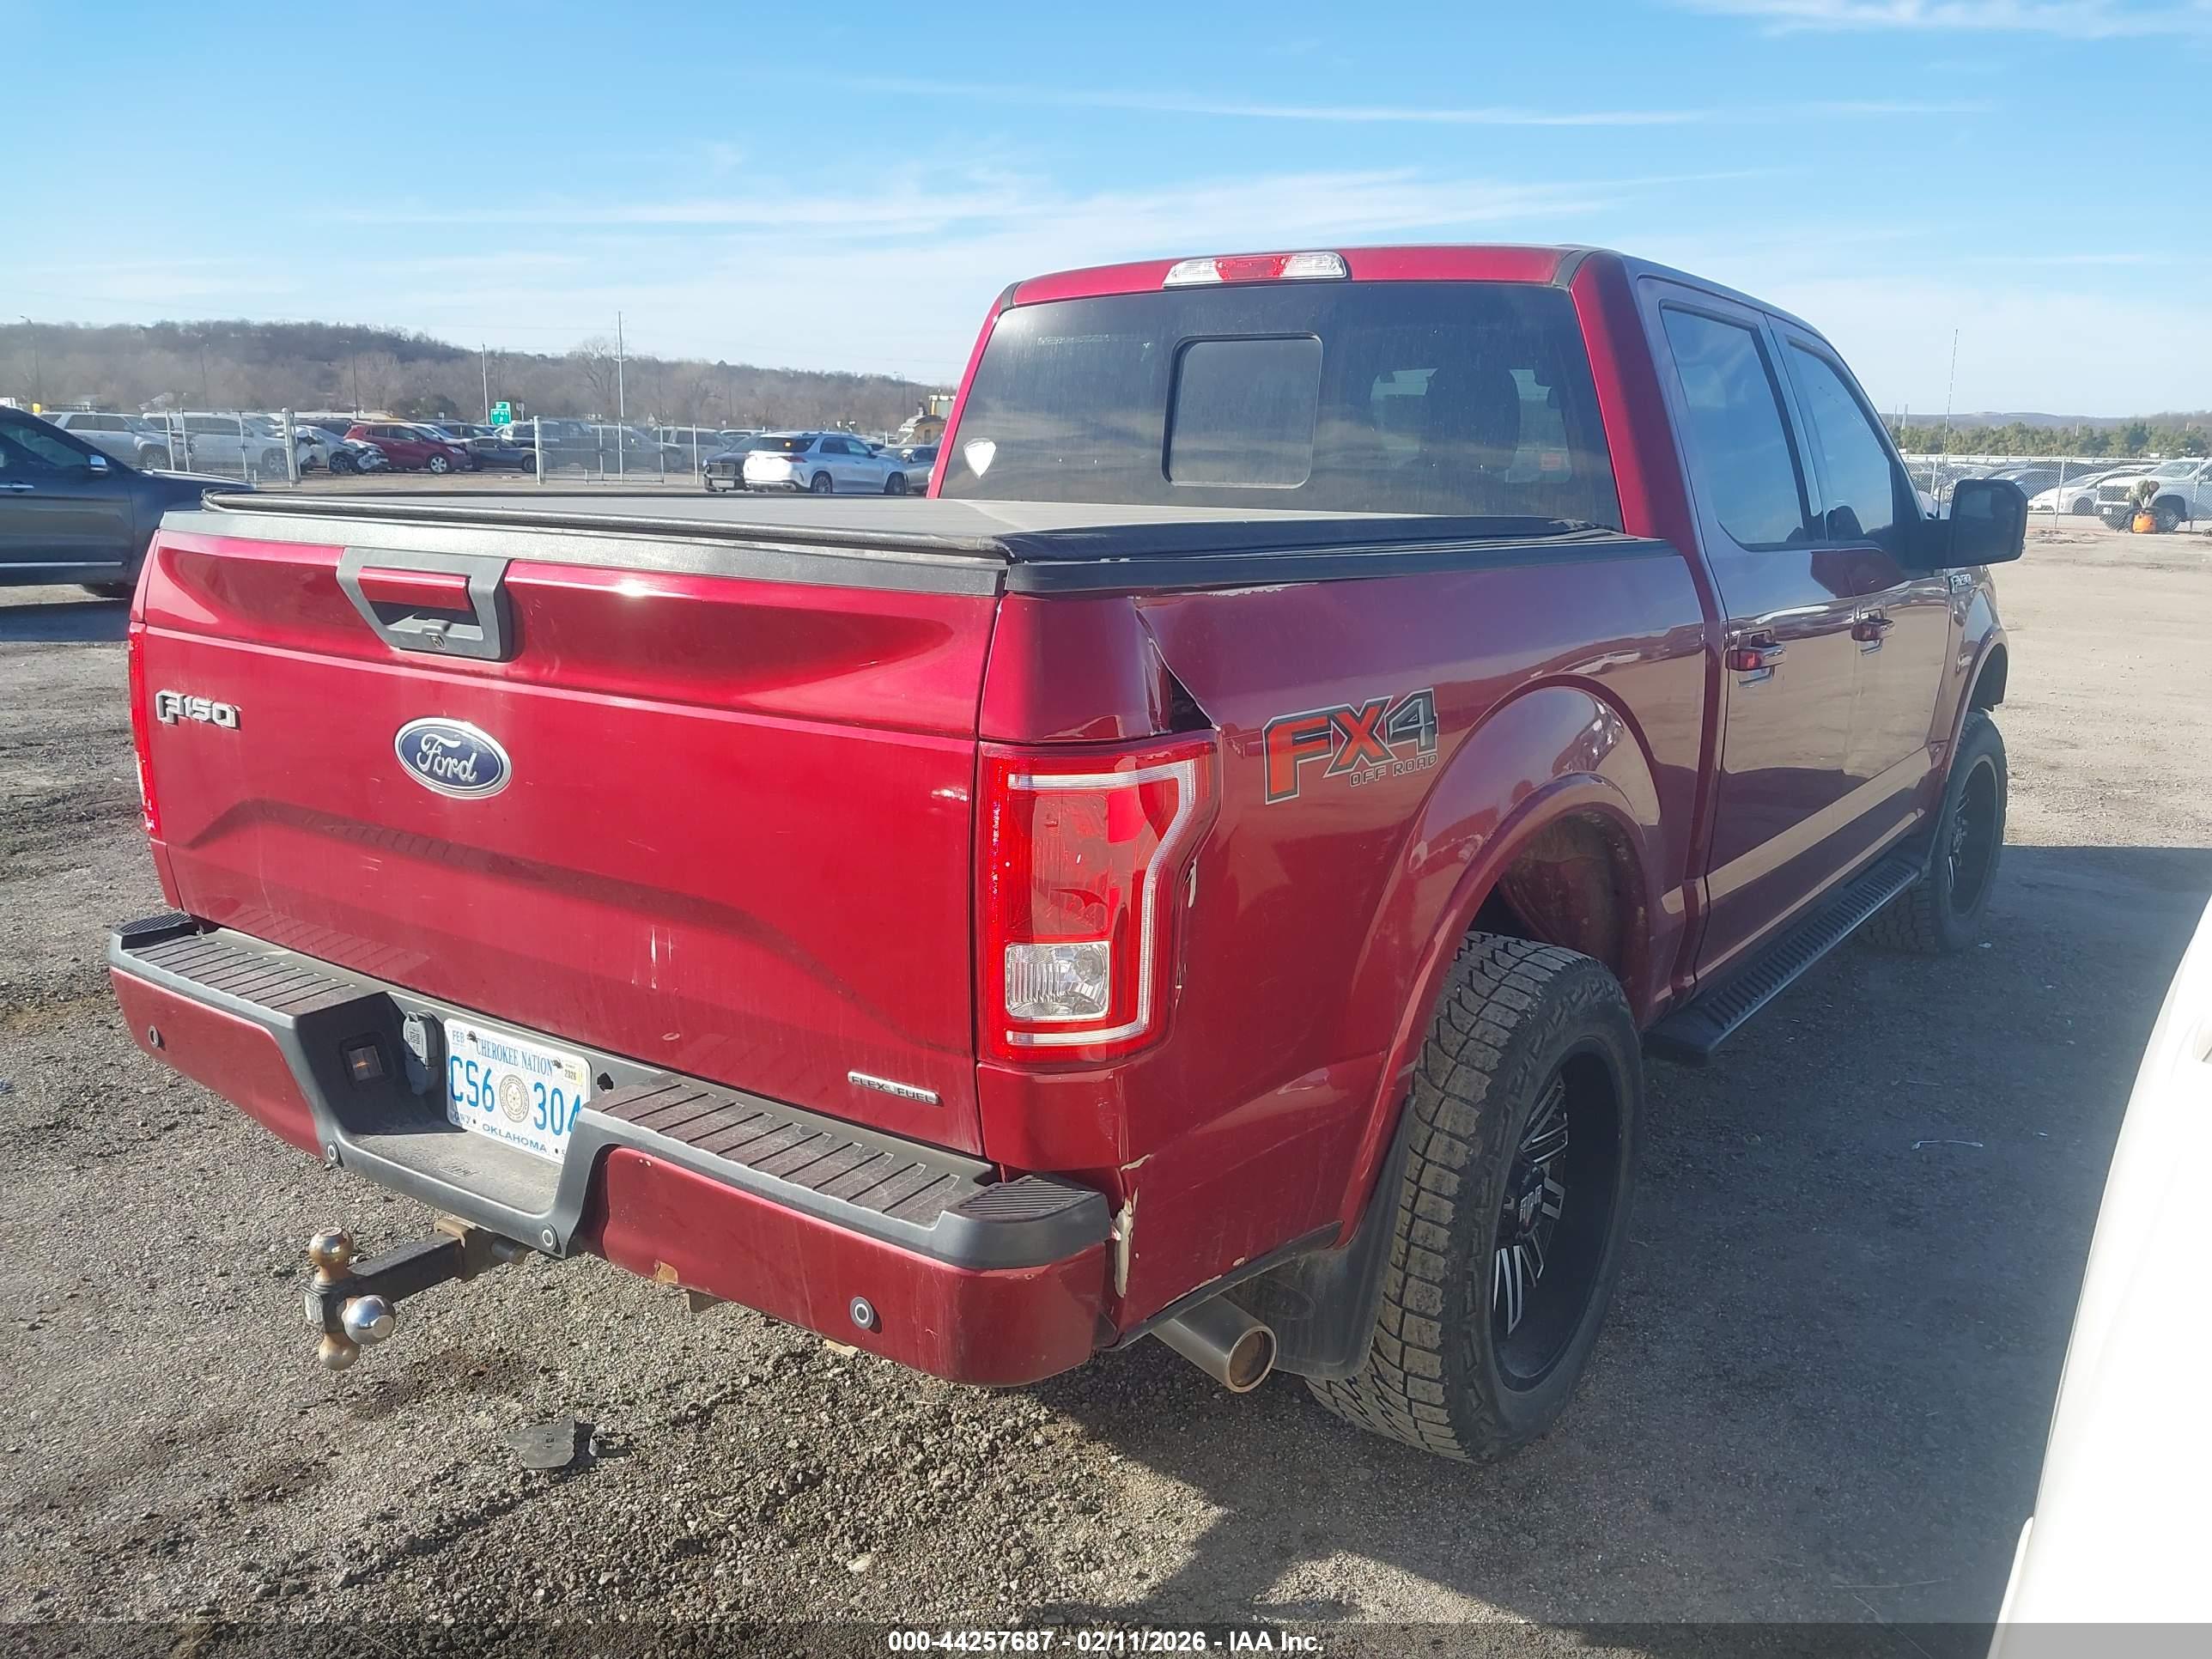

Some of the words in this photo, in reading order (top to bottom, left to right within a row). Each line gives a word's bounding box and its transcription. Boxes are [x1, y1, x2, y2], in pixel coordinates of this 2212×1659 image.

[416, 732, 477, 783] Ford
[1262, 687, 1439, 805] FX4
[1349, 764, 1387, 787] OFF
[1393, 753, 1438, 777] ROAD
[452, 1030, 465, 1043] FEB
[477, 1038, 519, 1066] CHEROKEE
[521, 1050, 553, 1078] NATION
[450, 1055, 495, 1113] CS6
[851, 1075, 886, 1091] FLEX
[896, 1086, 934, 1104] FUEL
[482, 1122, 547, 1153] OKLAHOMA
